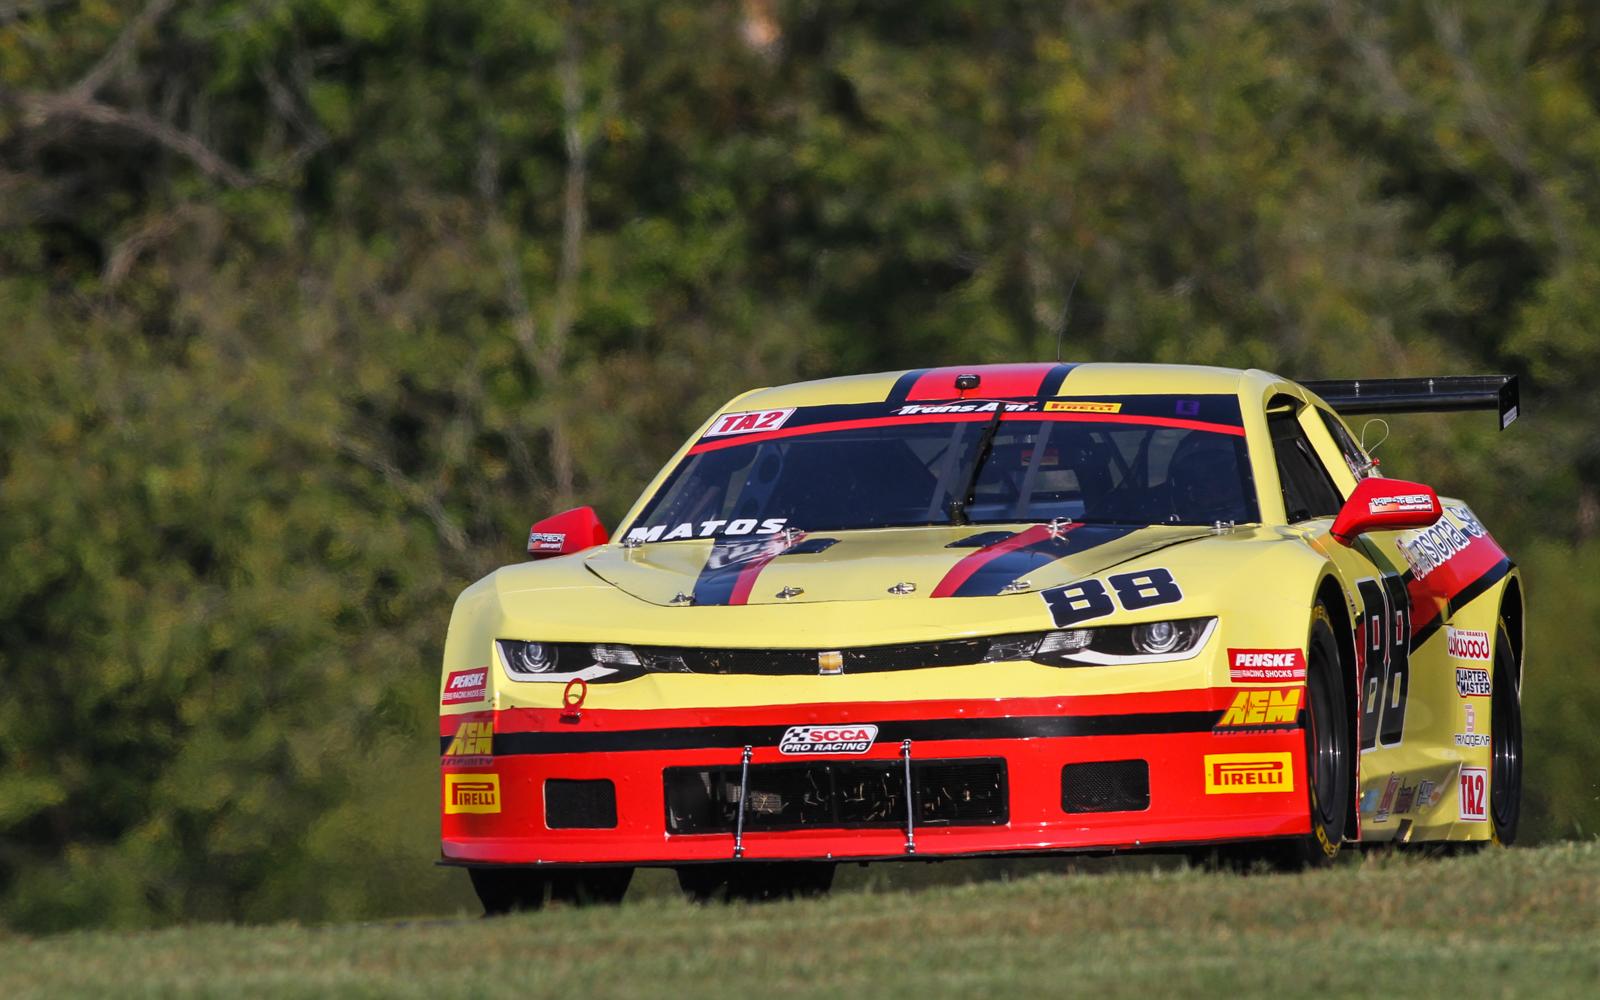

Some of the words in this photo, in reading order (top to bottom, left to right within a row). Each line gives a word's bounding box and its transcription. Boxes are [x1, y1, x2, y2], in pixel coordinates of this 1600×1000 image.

[898, 404, 977, 415] Trans
[1051, 402, 1114, 412] PIRELLI
[718, 411, 784, 433] TA2
[627, 518, 788, 542] MATOS
[1040, 568, 1183, 628] 88
[1235, 653, 1295, 667] PENSKE
[1359, 575, 1412, 753] 88
[450, 672, 486, 689] PENSKE
[1265, 669, 1293, 678] SHOCKS
[1456, 669, 1487, 686] QUARTER
[1460, 681, 1490, 694] MASTER
[1218, 688, 1301, 725] AEM
[446, 721, 494, 755] AEM
[809, 729, 870, 742] SCCA
[783, 743, 812, 752] PRO
[813, 742, 868, 752] RACING
[1213, 761, 1284, 786] PIRELLI
[451, 782, 496, 806] PIRELLI
[1461, 774, 1484, 816] TA2
